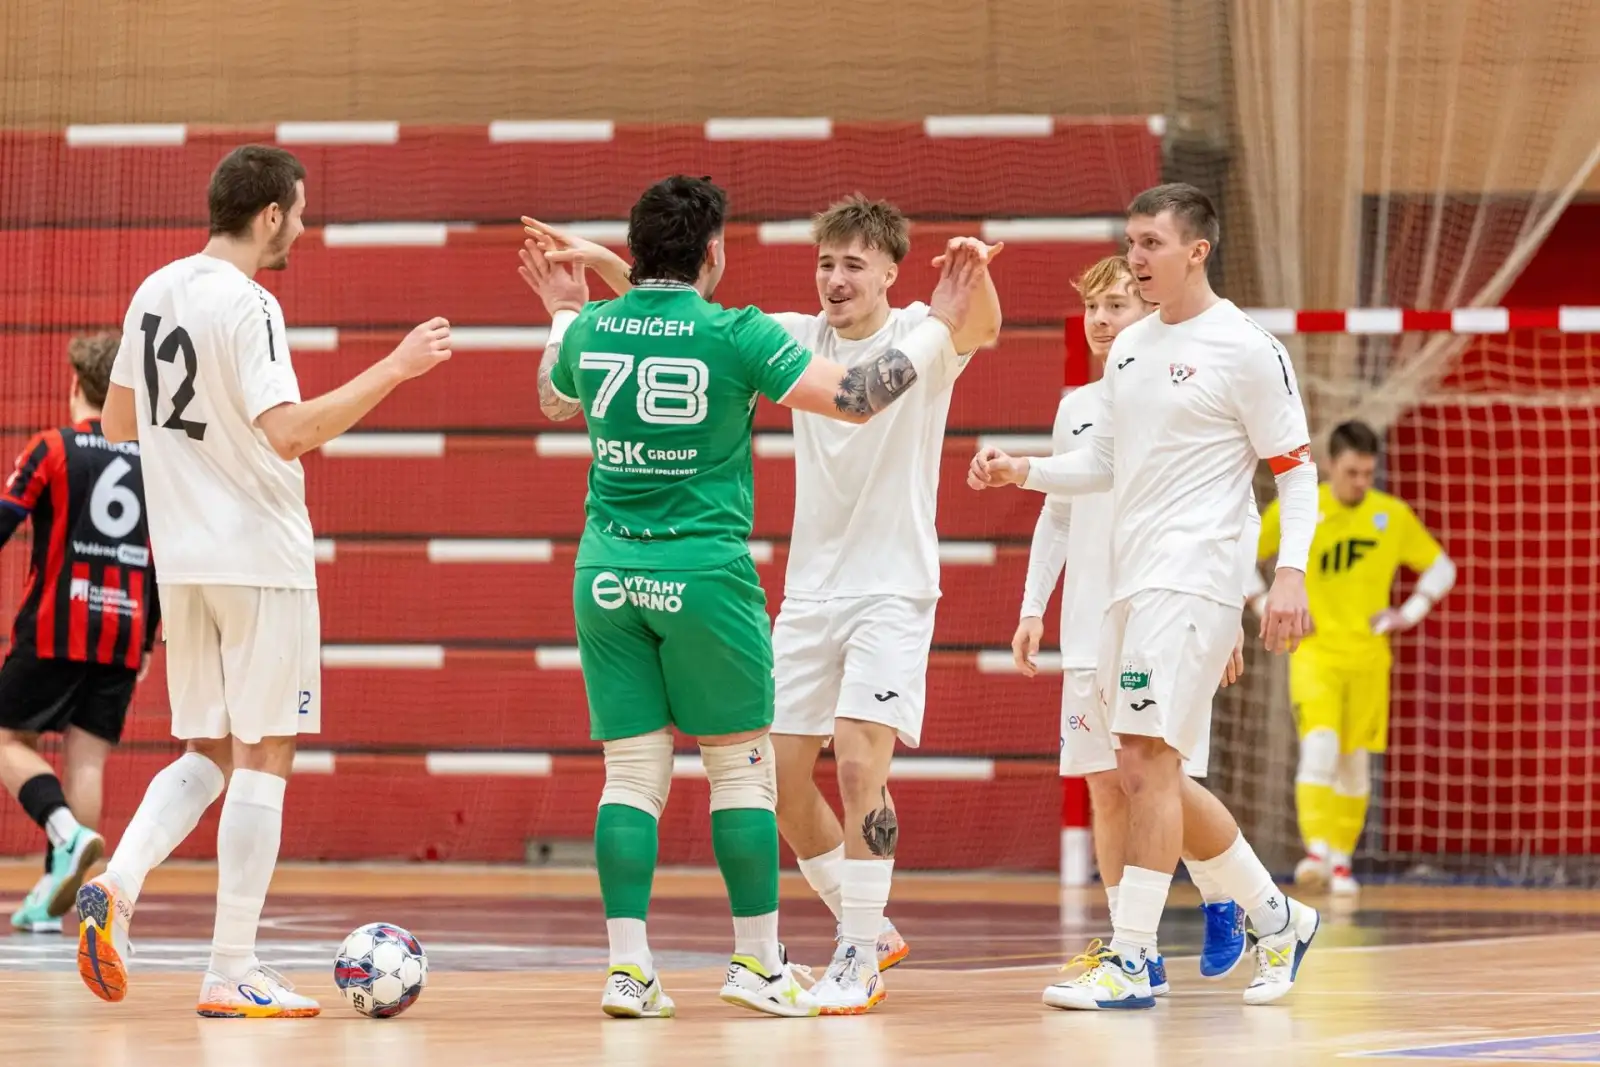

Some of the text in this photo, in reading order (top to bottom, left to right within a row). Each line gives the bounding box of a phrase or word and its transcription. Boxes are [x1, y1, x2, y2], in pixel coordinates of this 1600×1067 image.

[140, 312, 207, 441] 12
[579, 351, 709, 425] 78
[596, 437, 698, 465] PSK GROUP
[655, 468, 698, 476] SPOLEČNOST
[89, 455, 141, 539] 6
